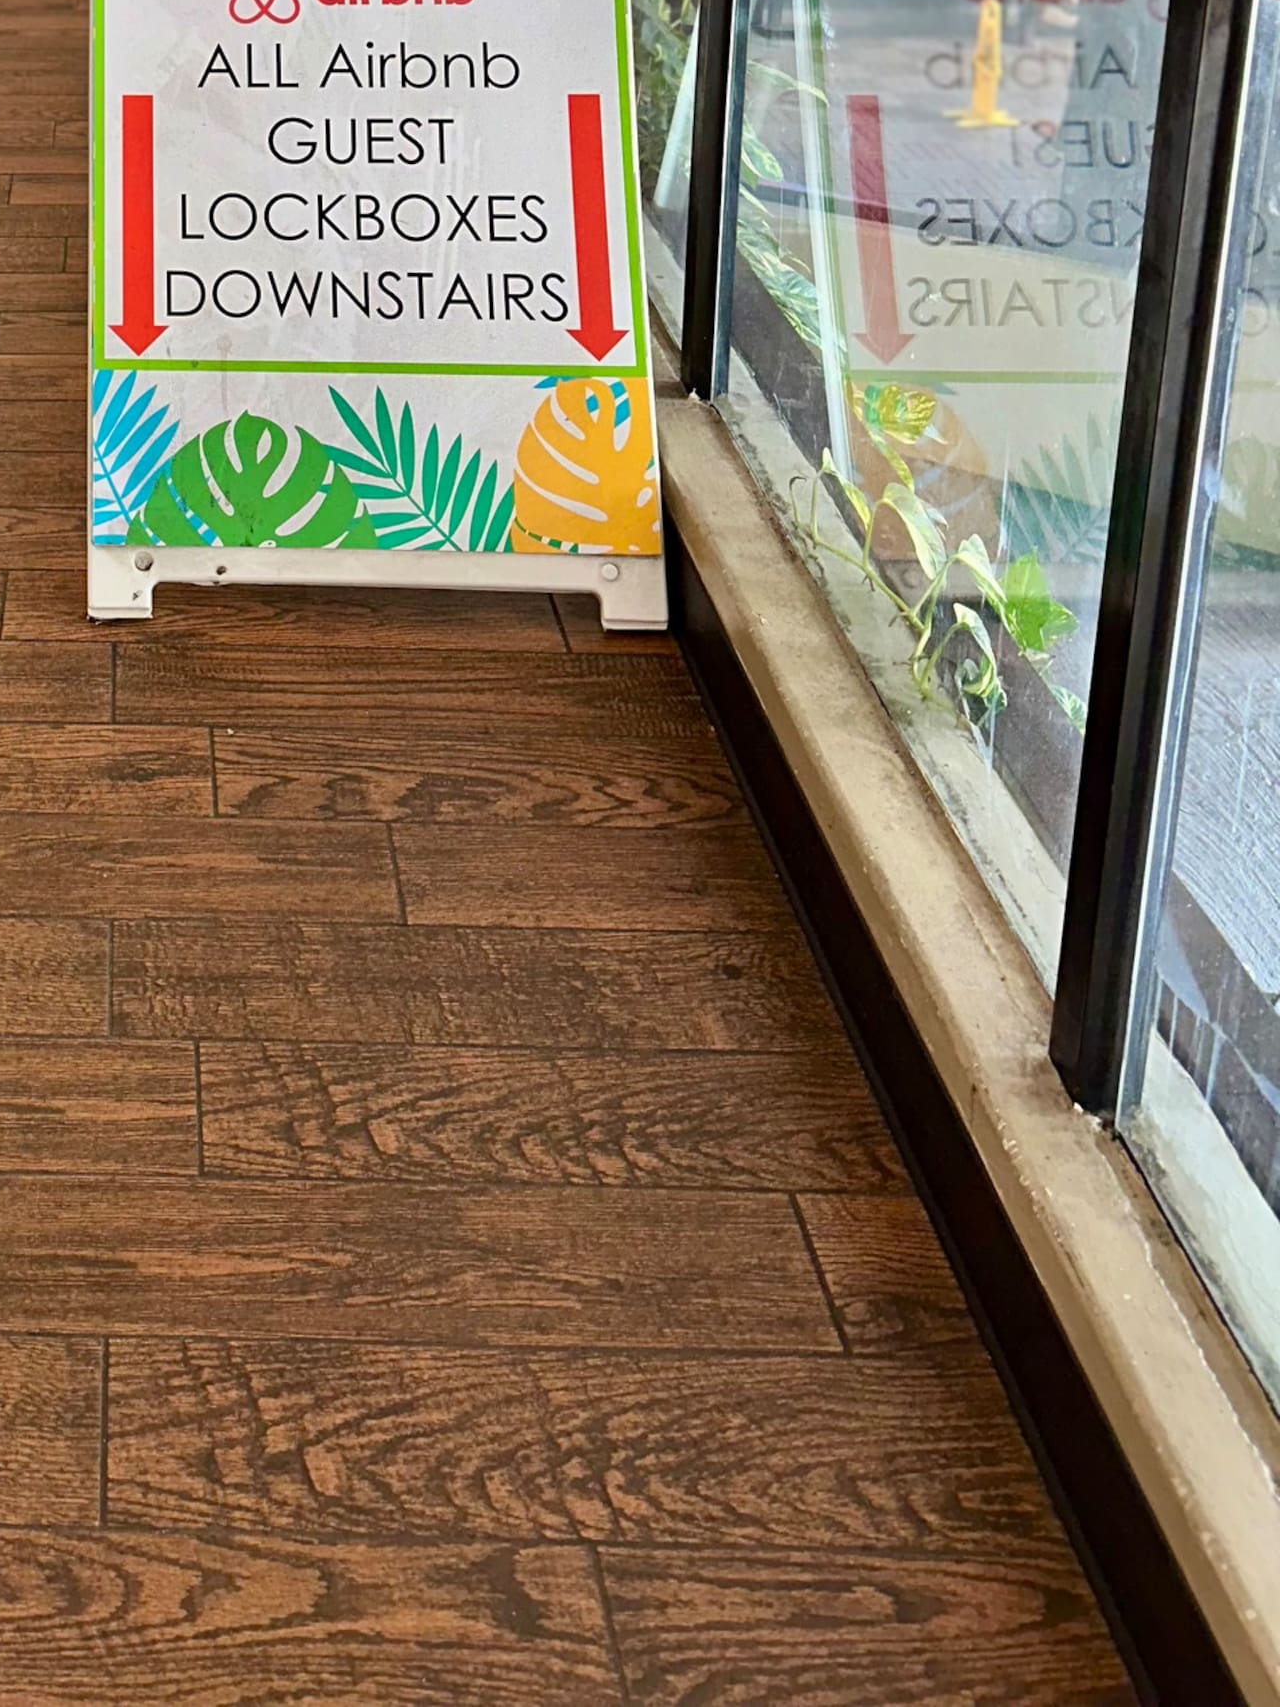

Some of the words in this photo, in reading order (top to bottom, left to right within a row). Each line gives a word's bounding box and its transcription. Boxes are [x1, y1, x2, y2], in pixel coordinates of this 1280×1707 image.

[197, 42, 300, 89] ALL
[319, 41, 521, 89] Airbnb
[267, 117, 455, 165] GUEST
[180, 192, 548, 243] LOCKBOXES
[165, 269, 569, 323] DOWNSTAIRS
